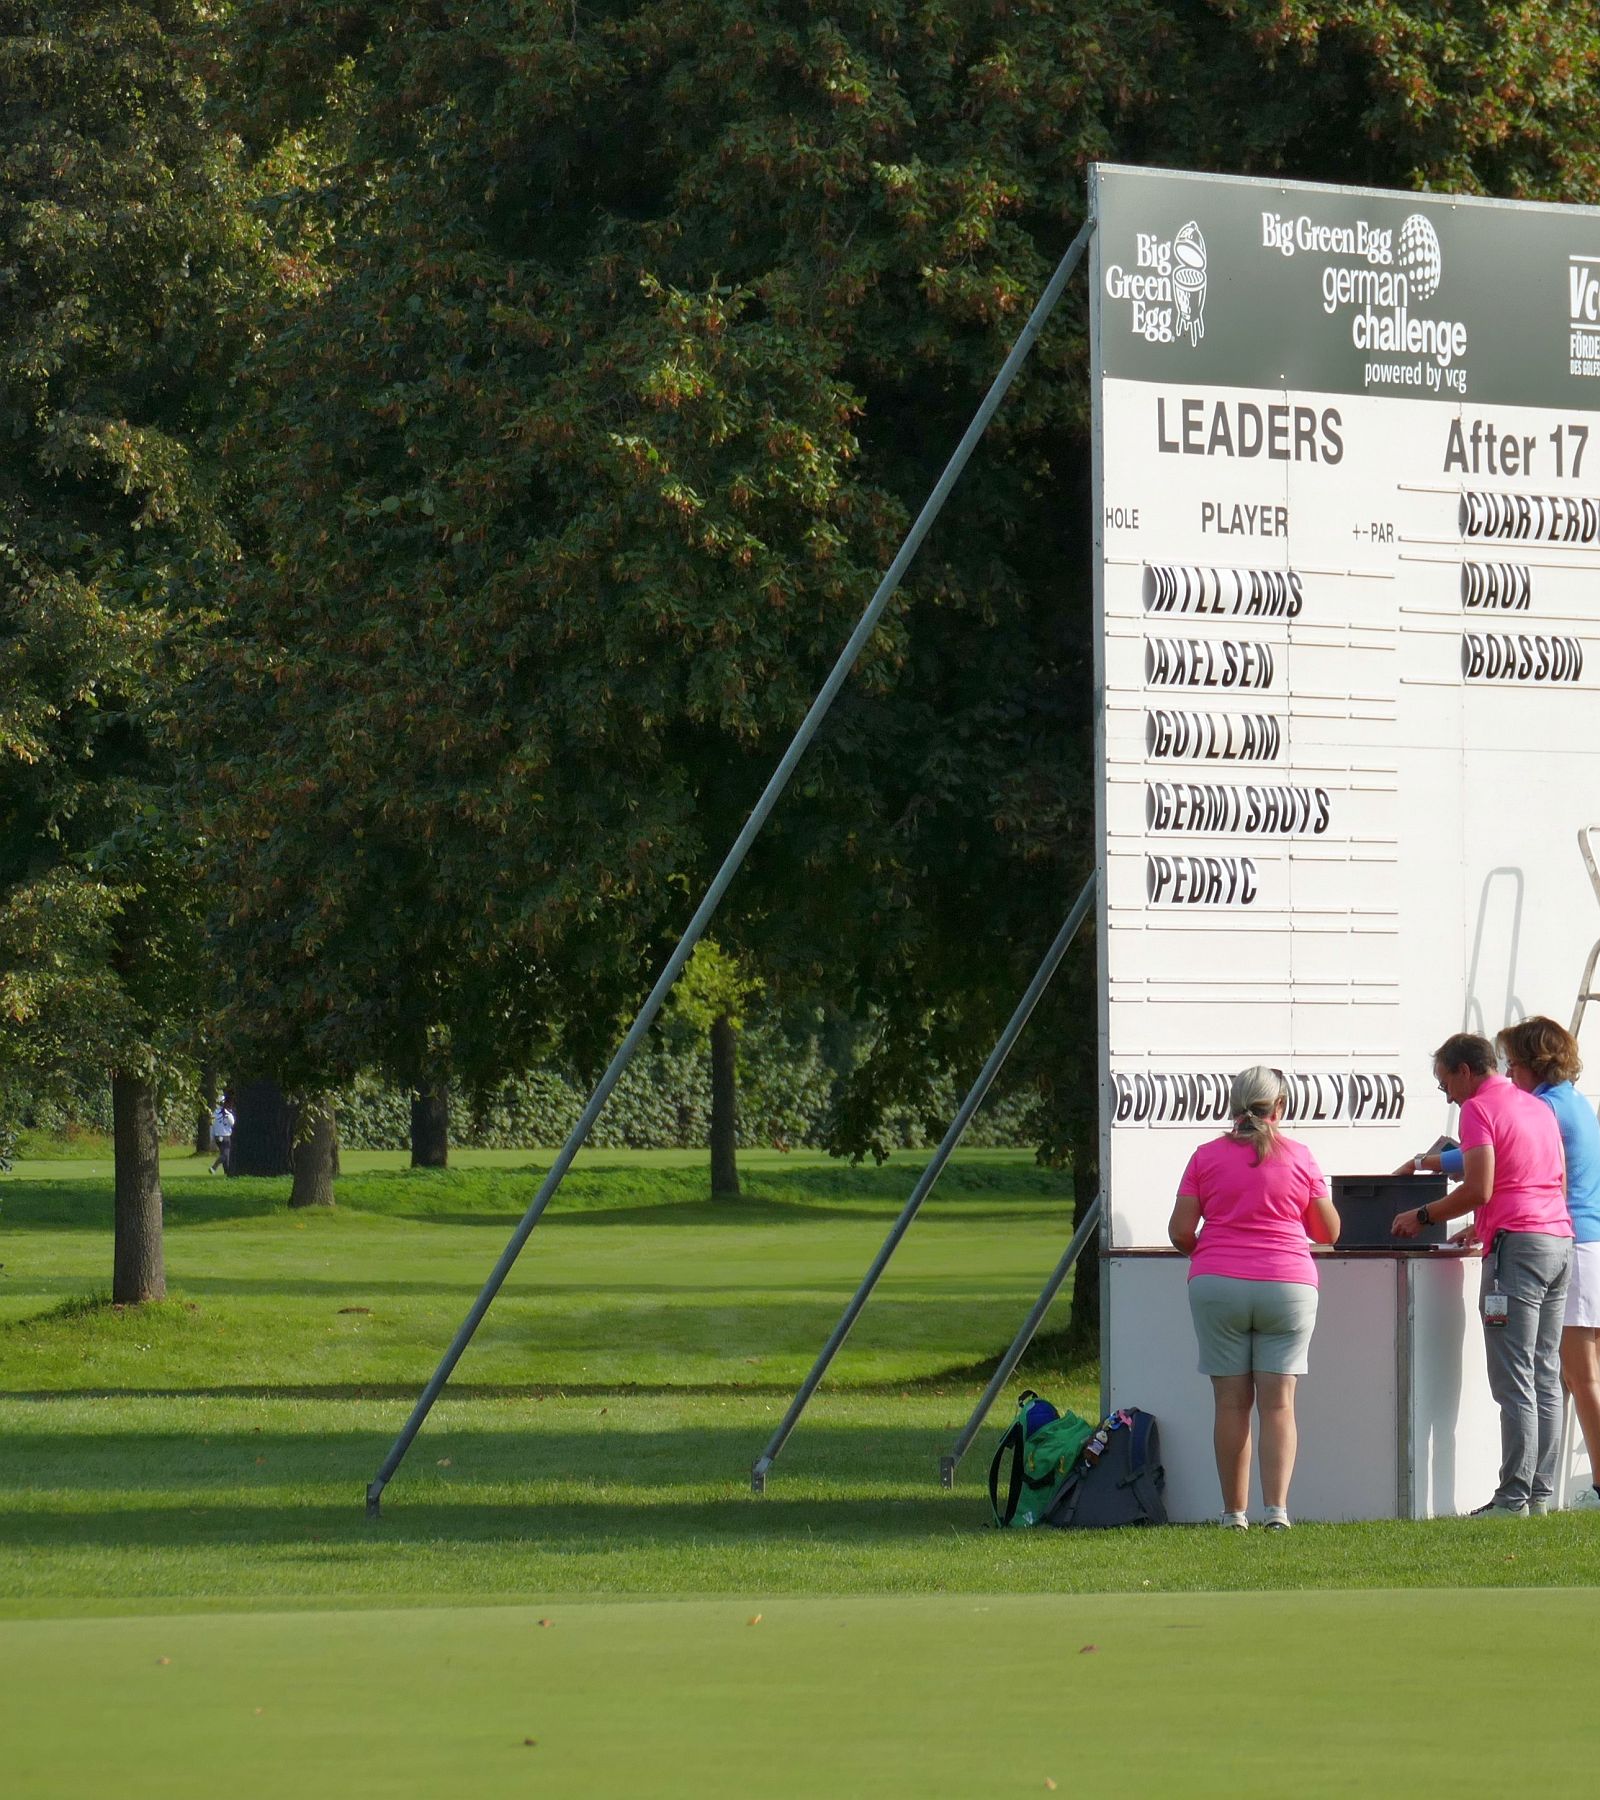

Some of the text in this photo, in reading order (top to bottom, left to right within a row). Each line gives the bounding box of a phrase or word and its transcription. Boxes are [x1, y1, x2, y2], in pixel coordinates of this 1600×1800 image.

[1136, 233, 1171, 276] Big
[1262, 212, 1392, 264] Big Green Egg
[1106, 265, 1172, 301] Green
[1322, 266, 1408, 313] german
[1132, 301, 1172, 342] Egg
[1353, 305, 1467, 366] challenge
[1365, 361, 1467, 393] powered by vcg
[1570, 360, 1581, 375] DES
[1158, 397, 1344, 465] LEADERS
[1443, 419, 1590, 479] After 17
[1105, 507, 1139, 530] HOLE
[1201, 502, 1289, 538] PLAYER
[1467, 491, 1598, 543] CUARTERO
[1154, 567, 1303, 618] WILLIAMS
[1467, 562, 1531, 610] DAUX
[1151, 639, 1274, 689] AXELSEN
[1467, 633, 1584, 681] BOASSON
[1154, 710, 1280, 760] GUILLAM
[1154, 782, 1331, 834] GERMISHUYS
[1153, 856, 1257, 904] PEDRYC
[1196, 1073, 1344, 1121] CUNTLY
[1355, 1074, 1406, 1121] PAR
